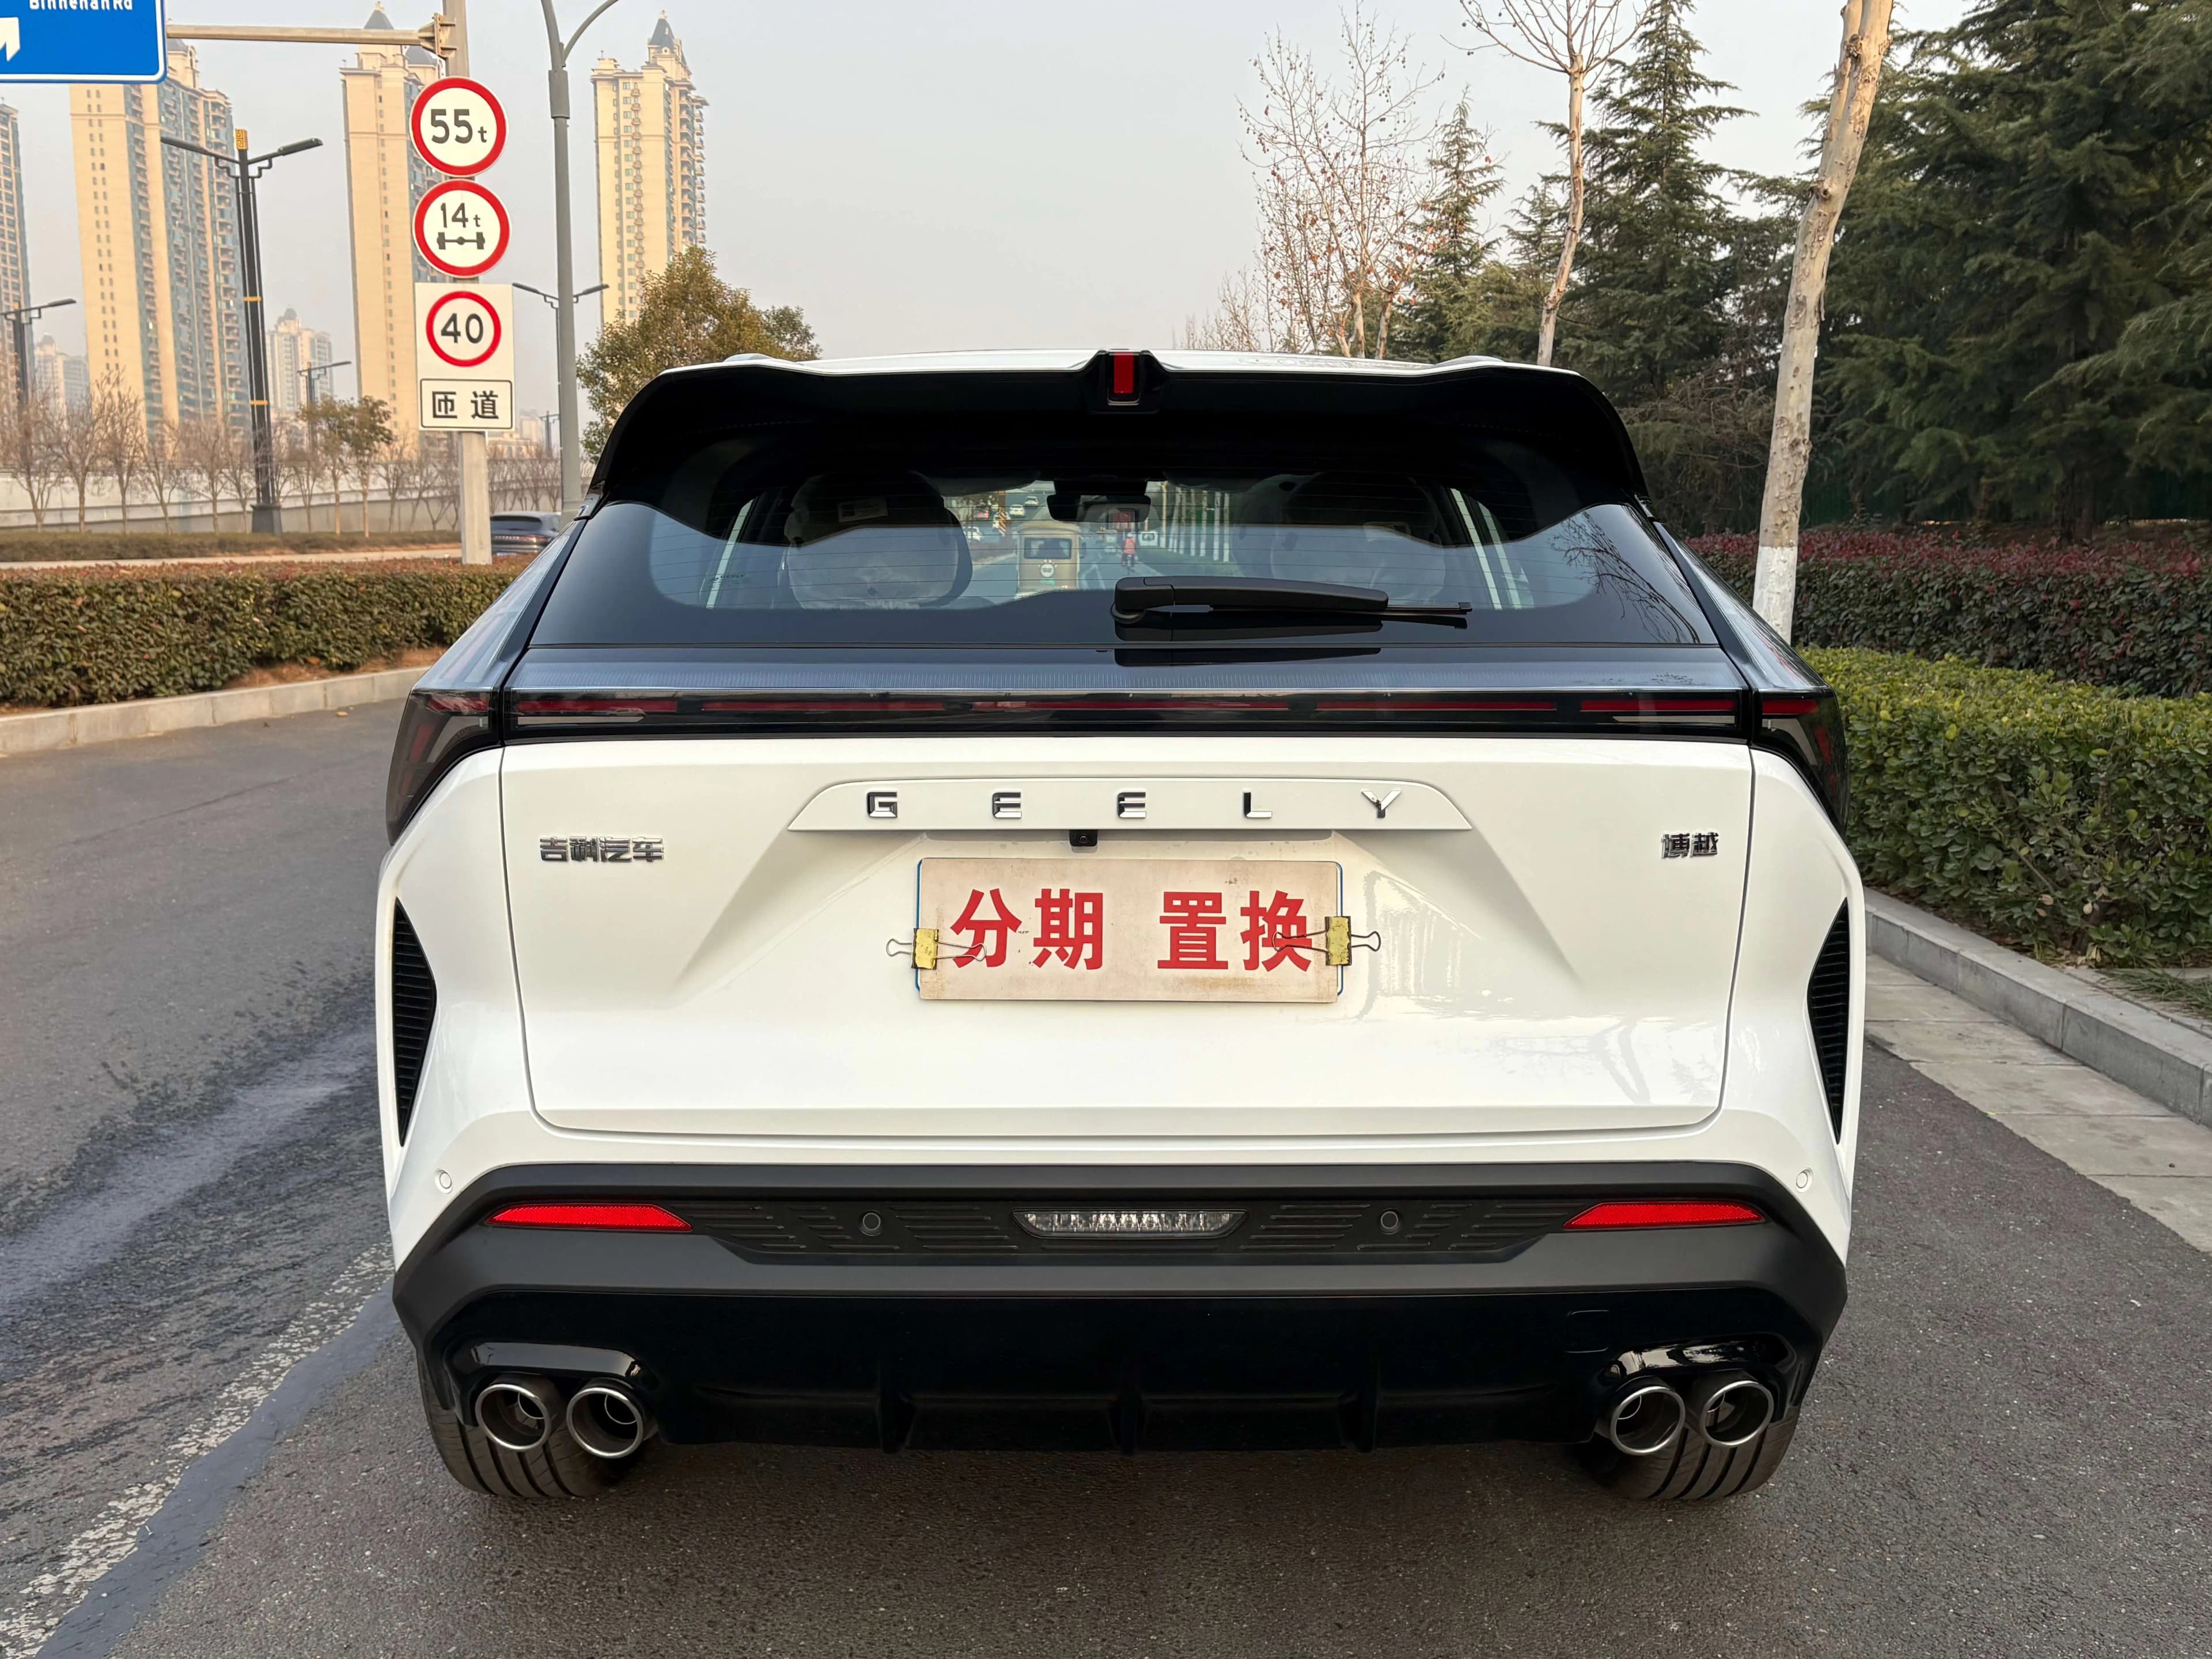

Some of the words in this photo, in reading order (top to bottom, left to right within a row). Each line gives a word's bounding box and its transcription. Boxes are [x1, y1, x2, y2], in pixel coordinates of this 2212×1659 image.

[441, 313, 484, 344] 40
[432, 391, 499, 419] 匝道
[866, 789, 1402, 819] GEELY
[540, 836, 664, 862] 吉利汽车
[1661, 832, 1719, 859] 博越
[951, 888, 1104, 970] 分期
[1157, 890, 1313, 972] 置换
